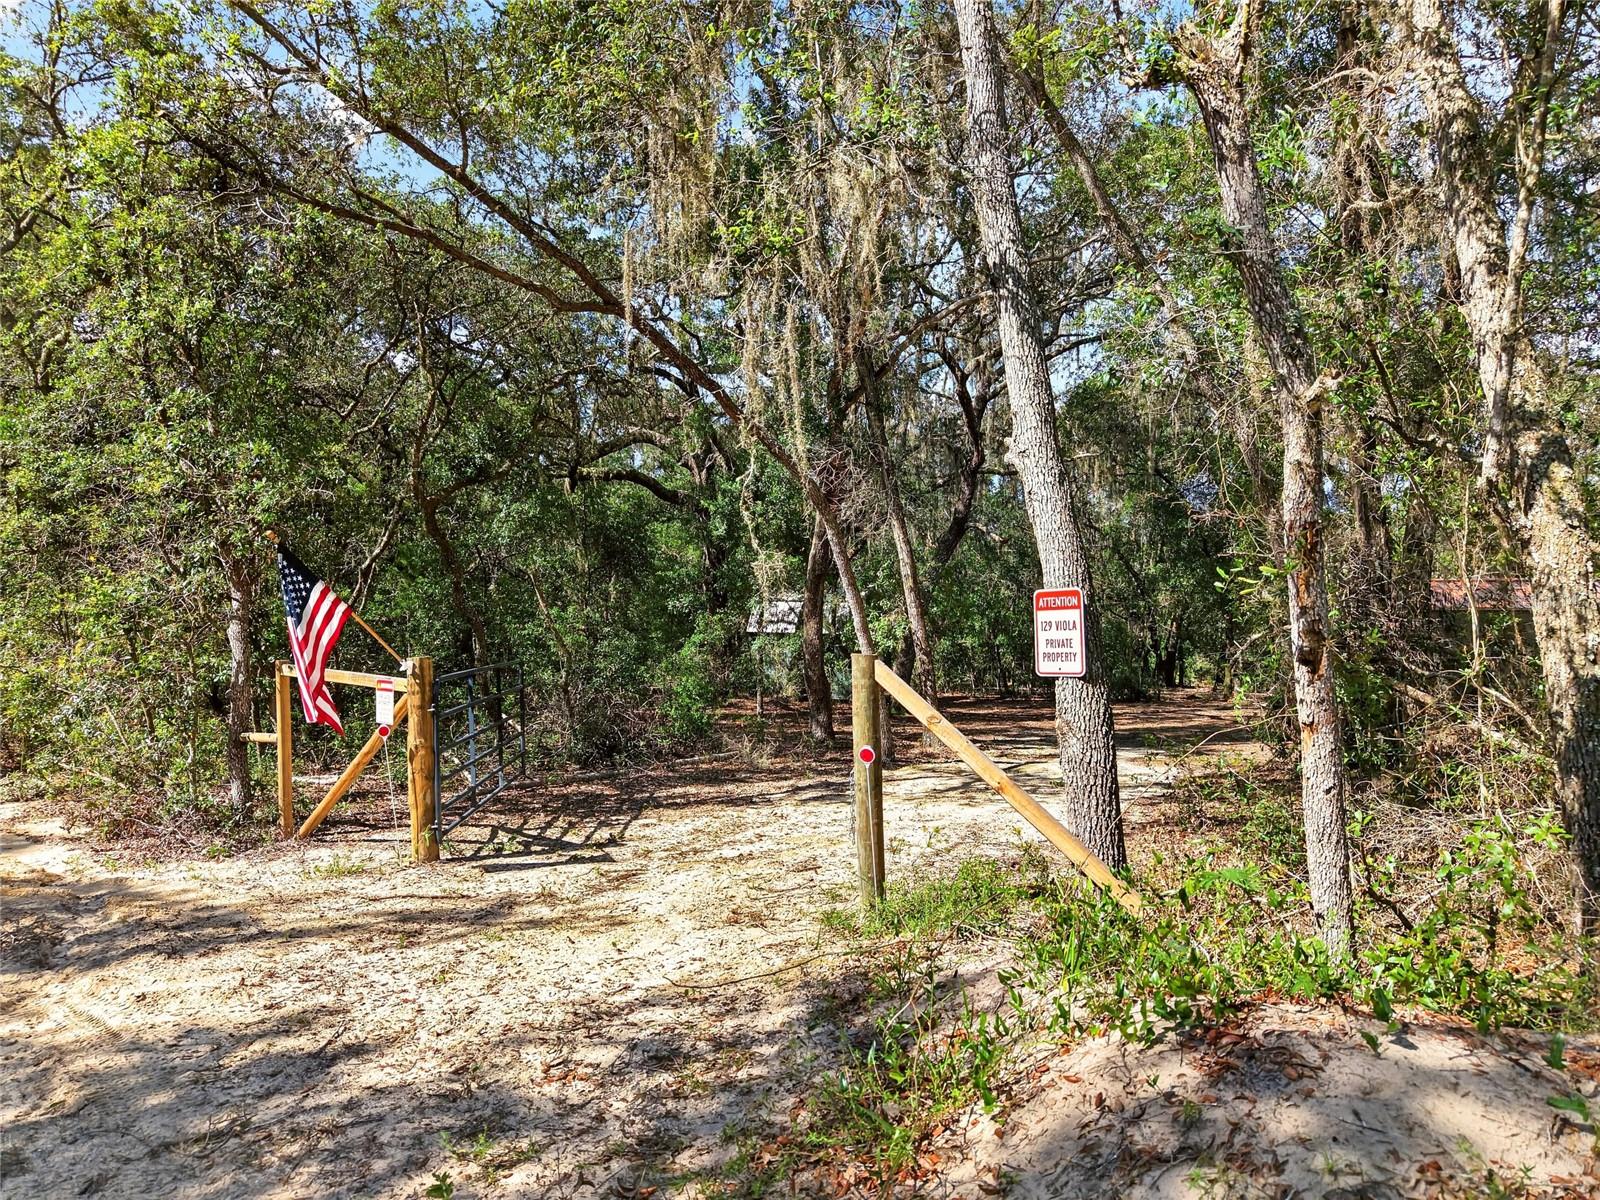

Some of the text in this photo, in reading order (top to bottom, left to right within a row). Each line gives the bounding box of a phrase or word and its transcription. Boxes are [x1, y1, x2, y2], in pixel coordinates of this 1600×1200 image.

[1039, 597, 1078, 608] ATTENTION
[1041, 620, 1077, 631] 129 VIOLA
[1045, 638, 1073, 648] PRIVATE
[1043, 652, 1077, 662] PROPERTY
